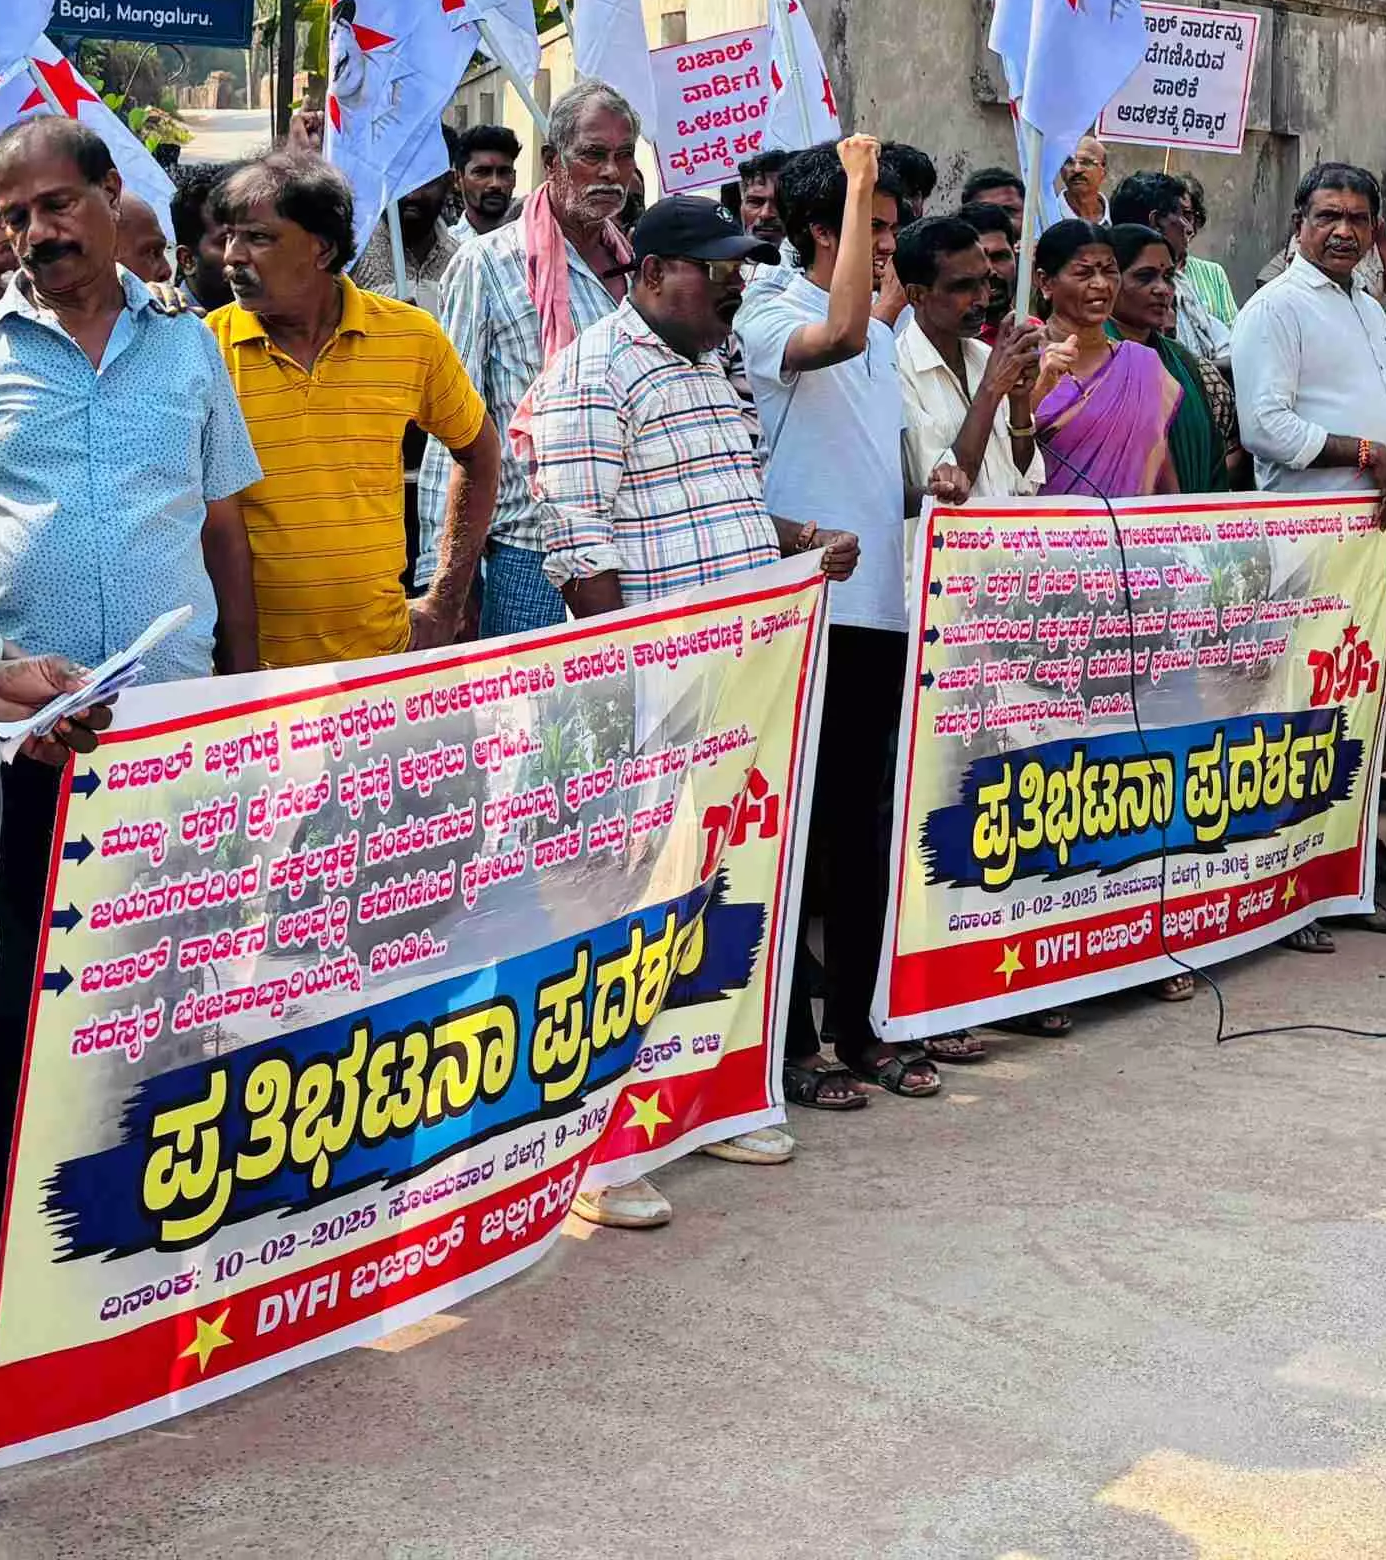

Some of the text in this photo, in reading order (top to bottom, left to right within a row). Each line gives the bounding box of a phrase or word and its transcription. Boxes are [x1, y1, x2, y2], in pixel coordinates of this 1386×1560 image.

[60, 0, 214, 28] Bajal, Mangaluru.
[677, 37, 753, 73] ಬಜಾಲ್
[1145, 42, 1225, 70] ಡೆಗಣಿಸಿರುವ
[682, 65, 760, 104] ವಾರ್ಡಿಗೆ
[1153, 76, 1199, 98] ಪಾಲಿಕೆ
[946, 526, 993, 549] ಬಜಾಲ್
[107, 743, 193, 791] ಬಜಾಲ್
[205, 723, 279, 777] ಜಲ್ಲಿಗುಡ್ಡೆ
[289, 698, 396, 755] ಮುಖ್ಯರಸ್ತೆಯ
[405, 665, 555, 721] ಅಗಲೀಕರಣಗೊಳಿಸಿ
[563, 644, 626, 684] ಕೂಡಲೇ
[92, 858, 260, 929] ಜಯನಗರದಿಂದ
[365, 801, 475, 862] ಸಂಪರ್ಕಿಸುವ
[483, 780, 558, 833] ರಸ್ತೆಯನ್ನು
[564, 760, 614, 810] ಪುನರ್
[101, 819, 167, 862] ಮುಖ್ಯ
[182, 794, 238, 850] ರಸ್ತೆಗೆ
[247, 773, 330, 837] ಡ್ರೈನೇಜ್
[340, 756, 391, 817] ವ್ಯವಸ್ಥೆ
[400, 743, 465, 795] ಕಲ್ಪಿಸಲು
[973, 723, 1337, 883] ಪ್ರತಿಭಟನಾ ಪ್ರದರ್ಶನ
[80, 938, 170, 993] ಬಜಾಲ್
[178, 918, 268, 971] ವಾರ್ಡಿನ
[277, 900, 349, 948] ಅಭಿವೃದ್ಧಿ
[358, 861, 455, 923] ಕಡೆಗಣಿಸಿದ
[462, 851, 526, 906] ಸ್ಥಳೀಯ
[534, 829, 582, 868] ಶಾಸಕ
[589, 813, 626, 855] ಮತ್ತು
[1011, 886, 1098, 921] 10-02-2025
[1036, 930, 1081, 968] DYFI
[1086, 909, 1153, 956] ಬಜಾಲ್
[1163, 892, 1231, 941] ಜಲ್ಲಿಗುಡ್ಡೆ
[70, 1000, 162, 1062] ಸದಸ್ಯರ
[173, 953, 361, 1033] ಬೇಜವಾಬ್ದಾರಿಯನ್ನು
[143, 1003, 518, 1241] ಪ್ರತಿಭಟನಾ
[213, 1203, 377, 1284] 10-02-2025
[388, 1159, 496, 1221] ಸೋಮವಾರ
[504, 1131, 547, 1172] ಬೆಳಗ್ಗೆ
[256, 1160, 579, 1337] DYFI ಬಜಾಲ್ ಜಲ್ಲಿಗುಡ್ಡೆ
